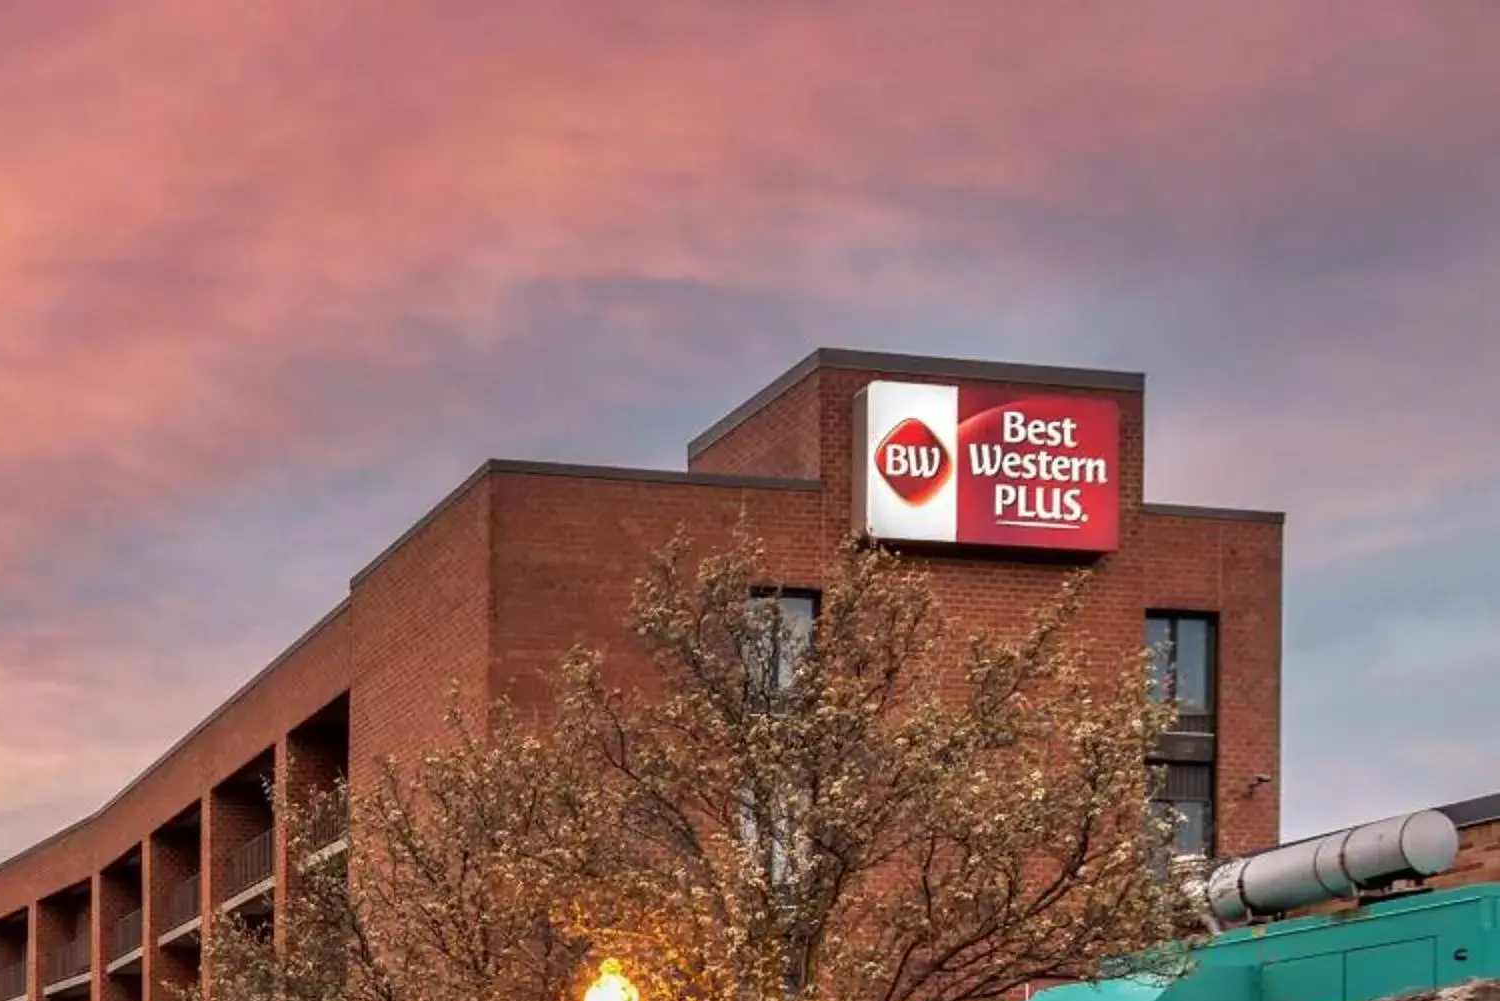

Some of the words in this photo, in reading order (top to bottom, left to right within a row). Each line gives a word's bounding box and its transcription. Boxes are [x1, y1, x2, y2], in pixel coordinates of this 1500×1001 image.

[1003, 411, 1077, 448] Best
[885, 444, 941, 478] BW
[968, 443, 1108, 483] Western
